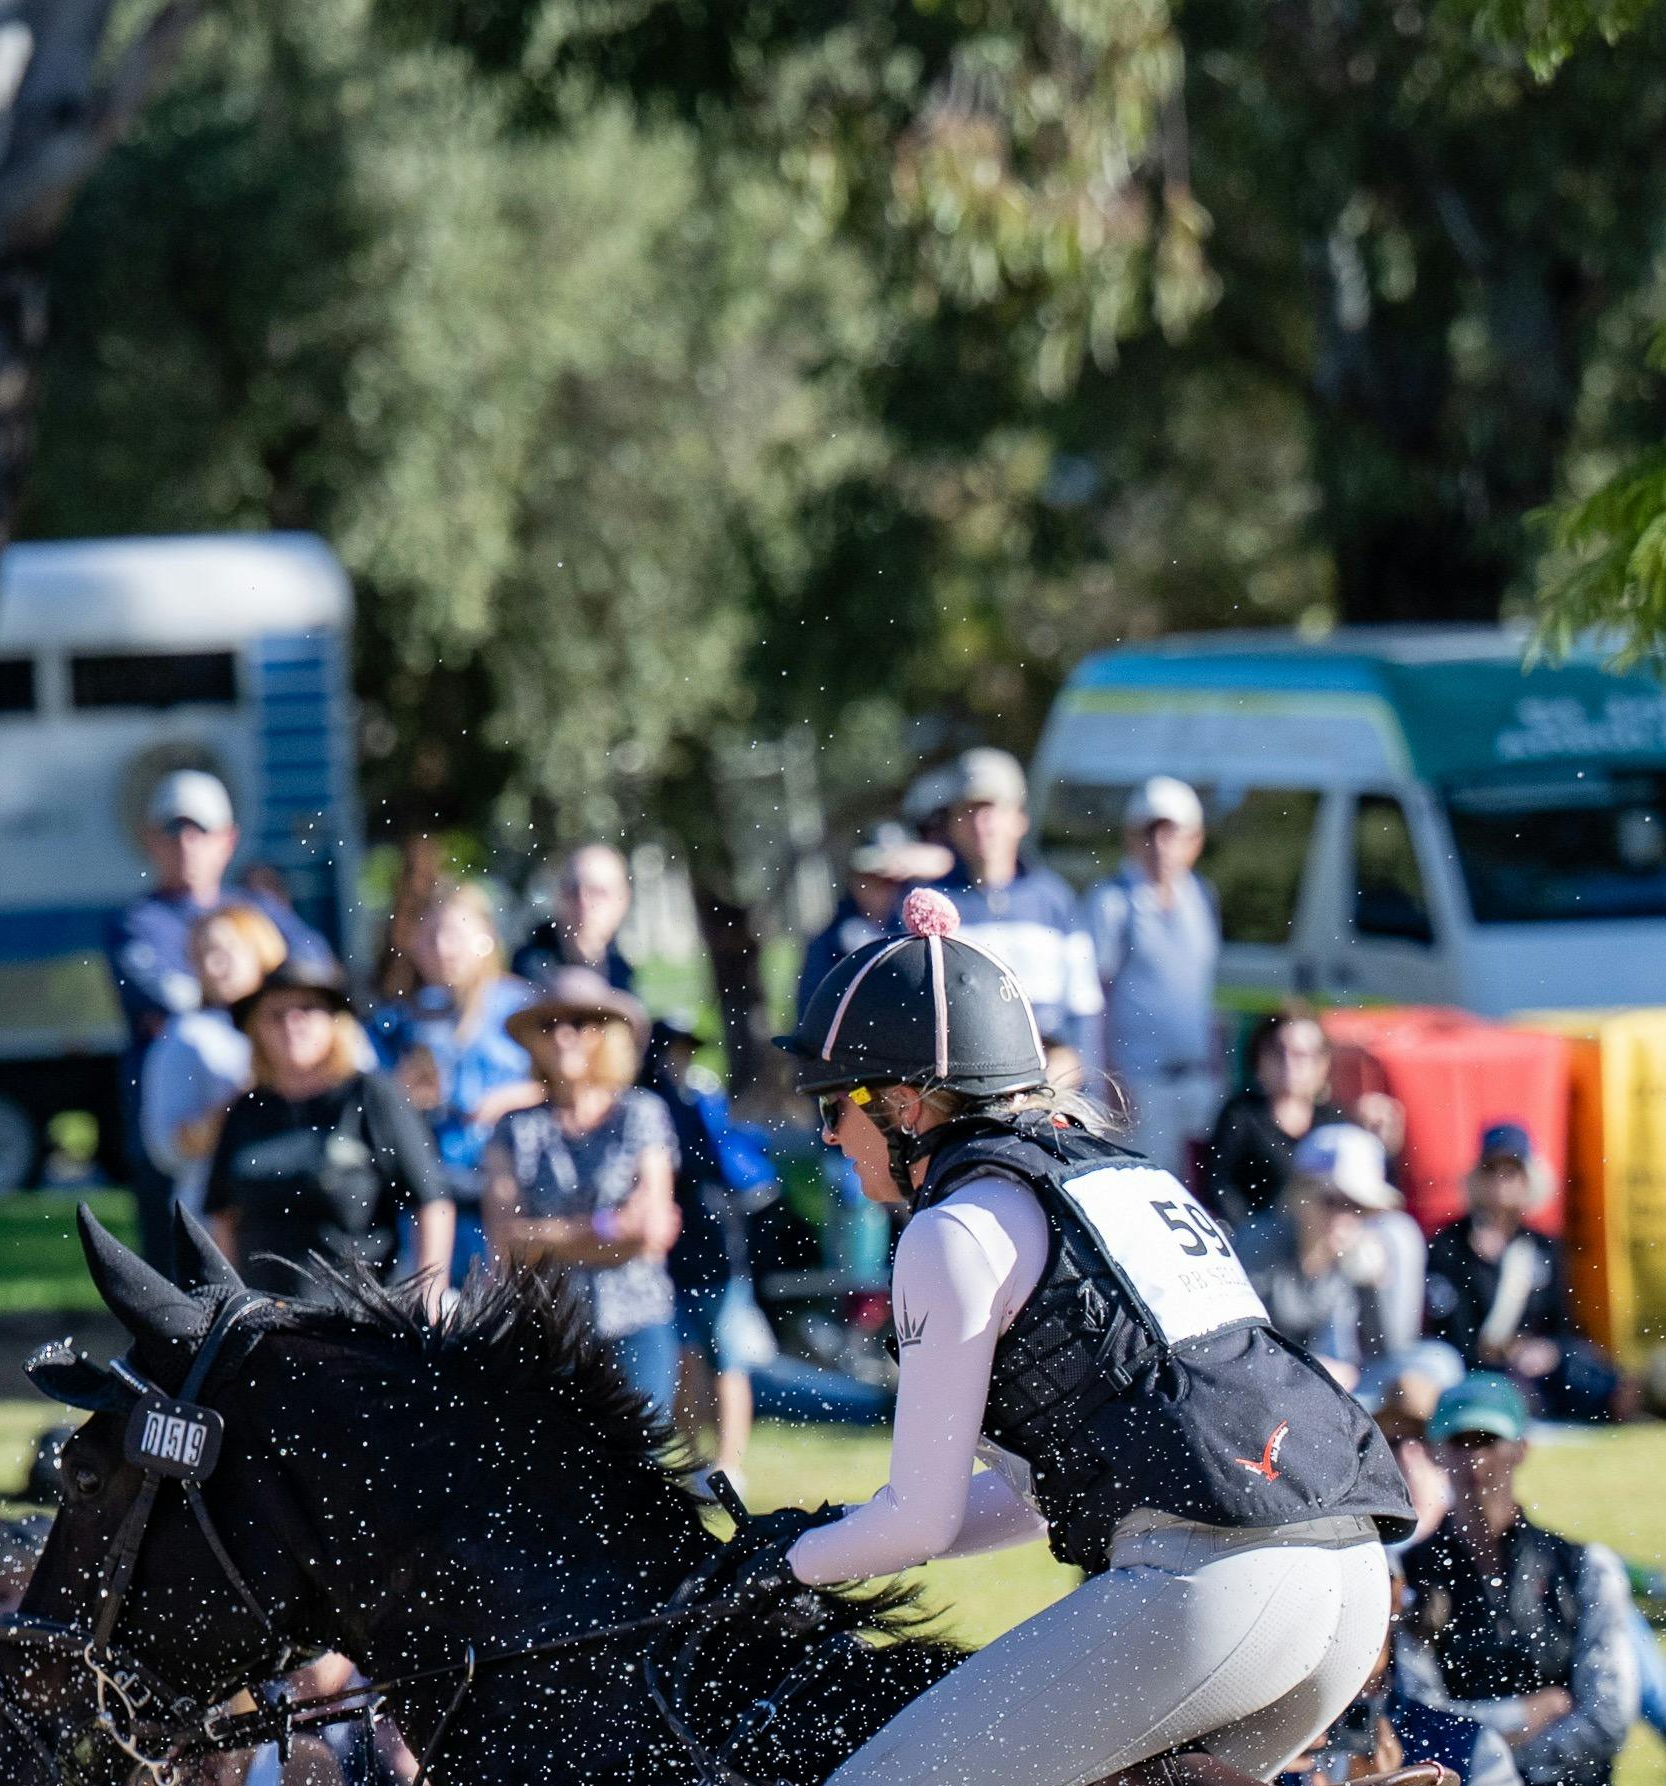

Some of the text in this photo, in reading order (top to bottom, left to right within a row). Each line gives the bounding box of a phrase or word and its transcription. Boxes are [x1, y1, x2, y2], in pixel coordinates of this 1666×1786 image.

[1149, 1200, 1231, 1258] 59
[1178, 1271, 1208, 1293] RB
[144, 1414, 206, 1465] 059
